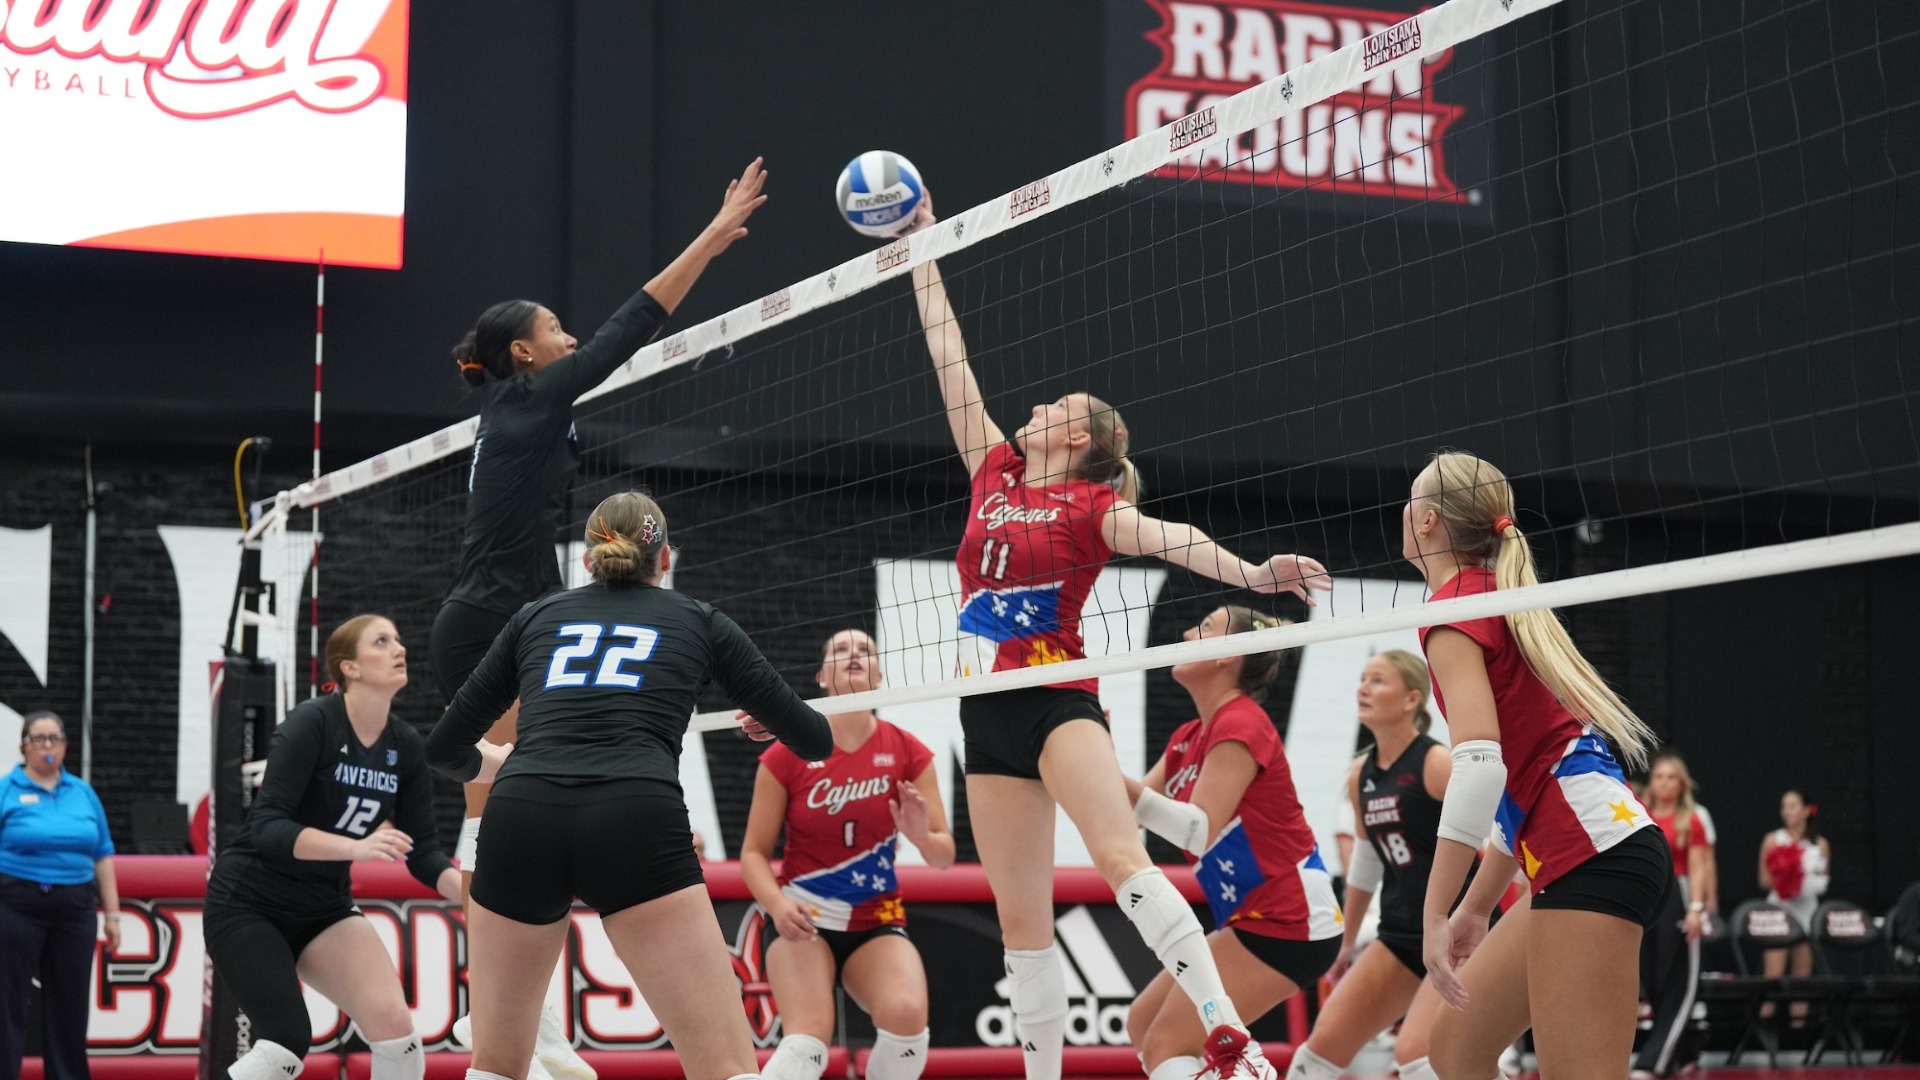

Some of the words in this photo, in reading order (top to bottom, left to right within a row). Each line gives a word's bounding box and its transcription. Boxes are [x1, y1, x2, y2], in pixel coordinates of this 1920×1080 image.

[1364, 18, 1420, 57] LOUISIANA
[1391, 34, 1421, 59] CAJUNS
[855, 191, 902, 208] molten
[976, 492, 1063, 531] Cajuns
[978, 538, 1014, 581] 11
[544, 622, 661, 690] 22
[806, 774, 891, 816] Cajuns
[334, 795, 382, 836] 12
[843, 820, 859, 848] 1
